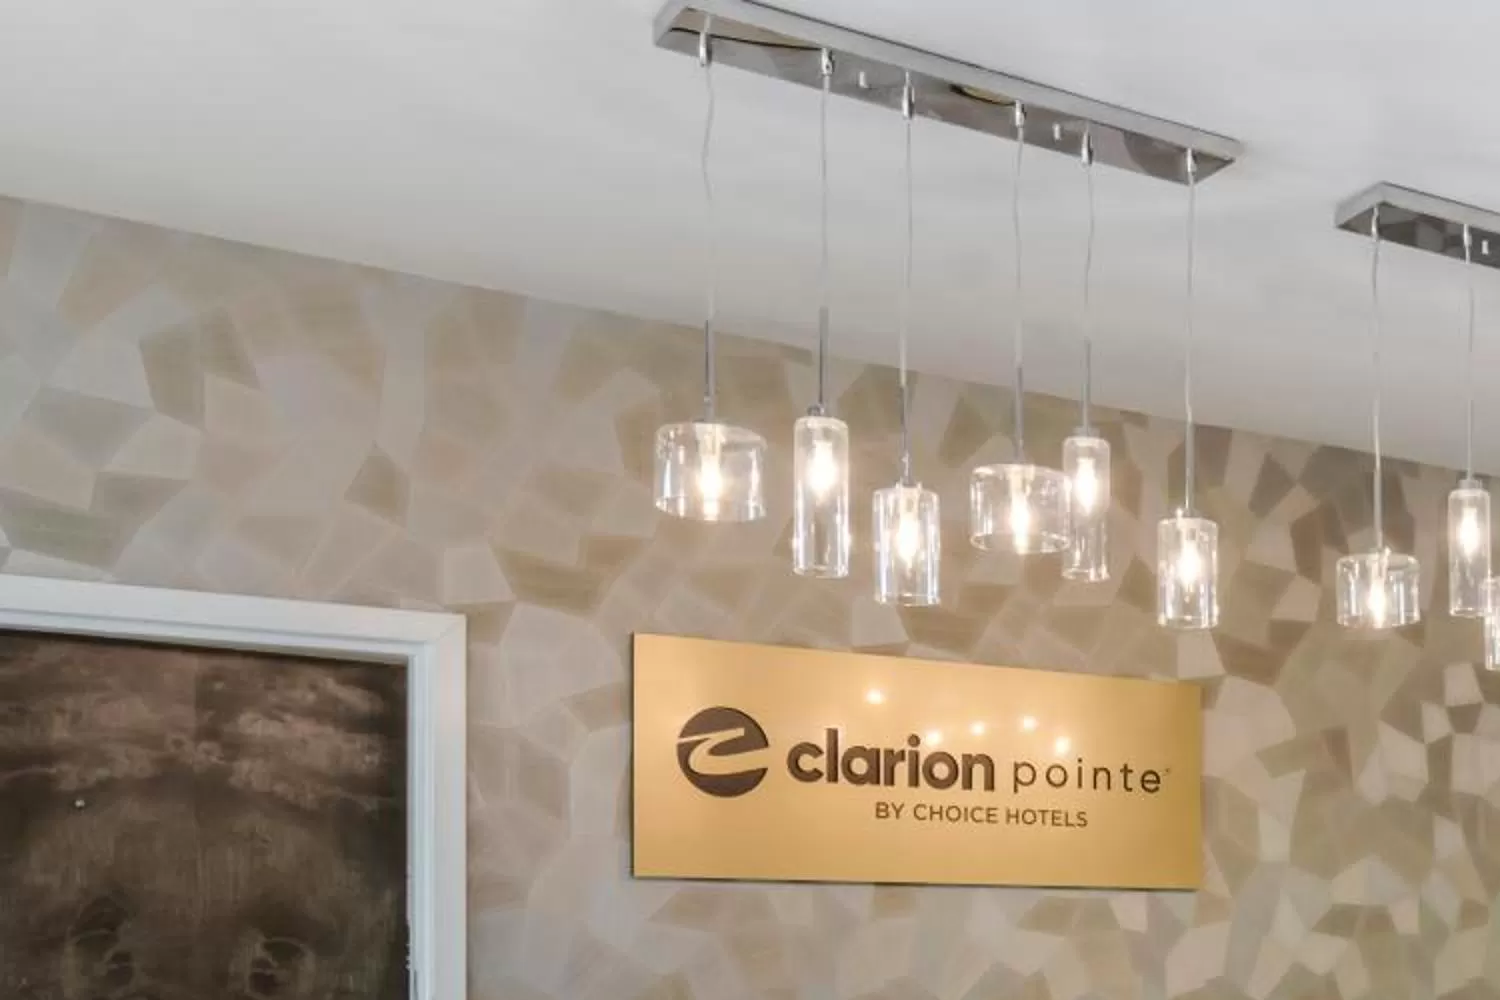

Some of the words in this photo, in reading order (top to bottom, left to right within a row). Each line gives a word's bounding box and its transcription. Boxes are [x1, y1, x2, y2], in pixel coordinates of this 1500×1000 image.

[786, 727, 995, 792] clarion
[1013, 757, 1162, 794] pointe
[874, 802, 905, 820] BY
[913, 803, 998, 825] CHOICE
[1005, 807, 1088, 828] HOTELS
